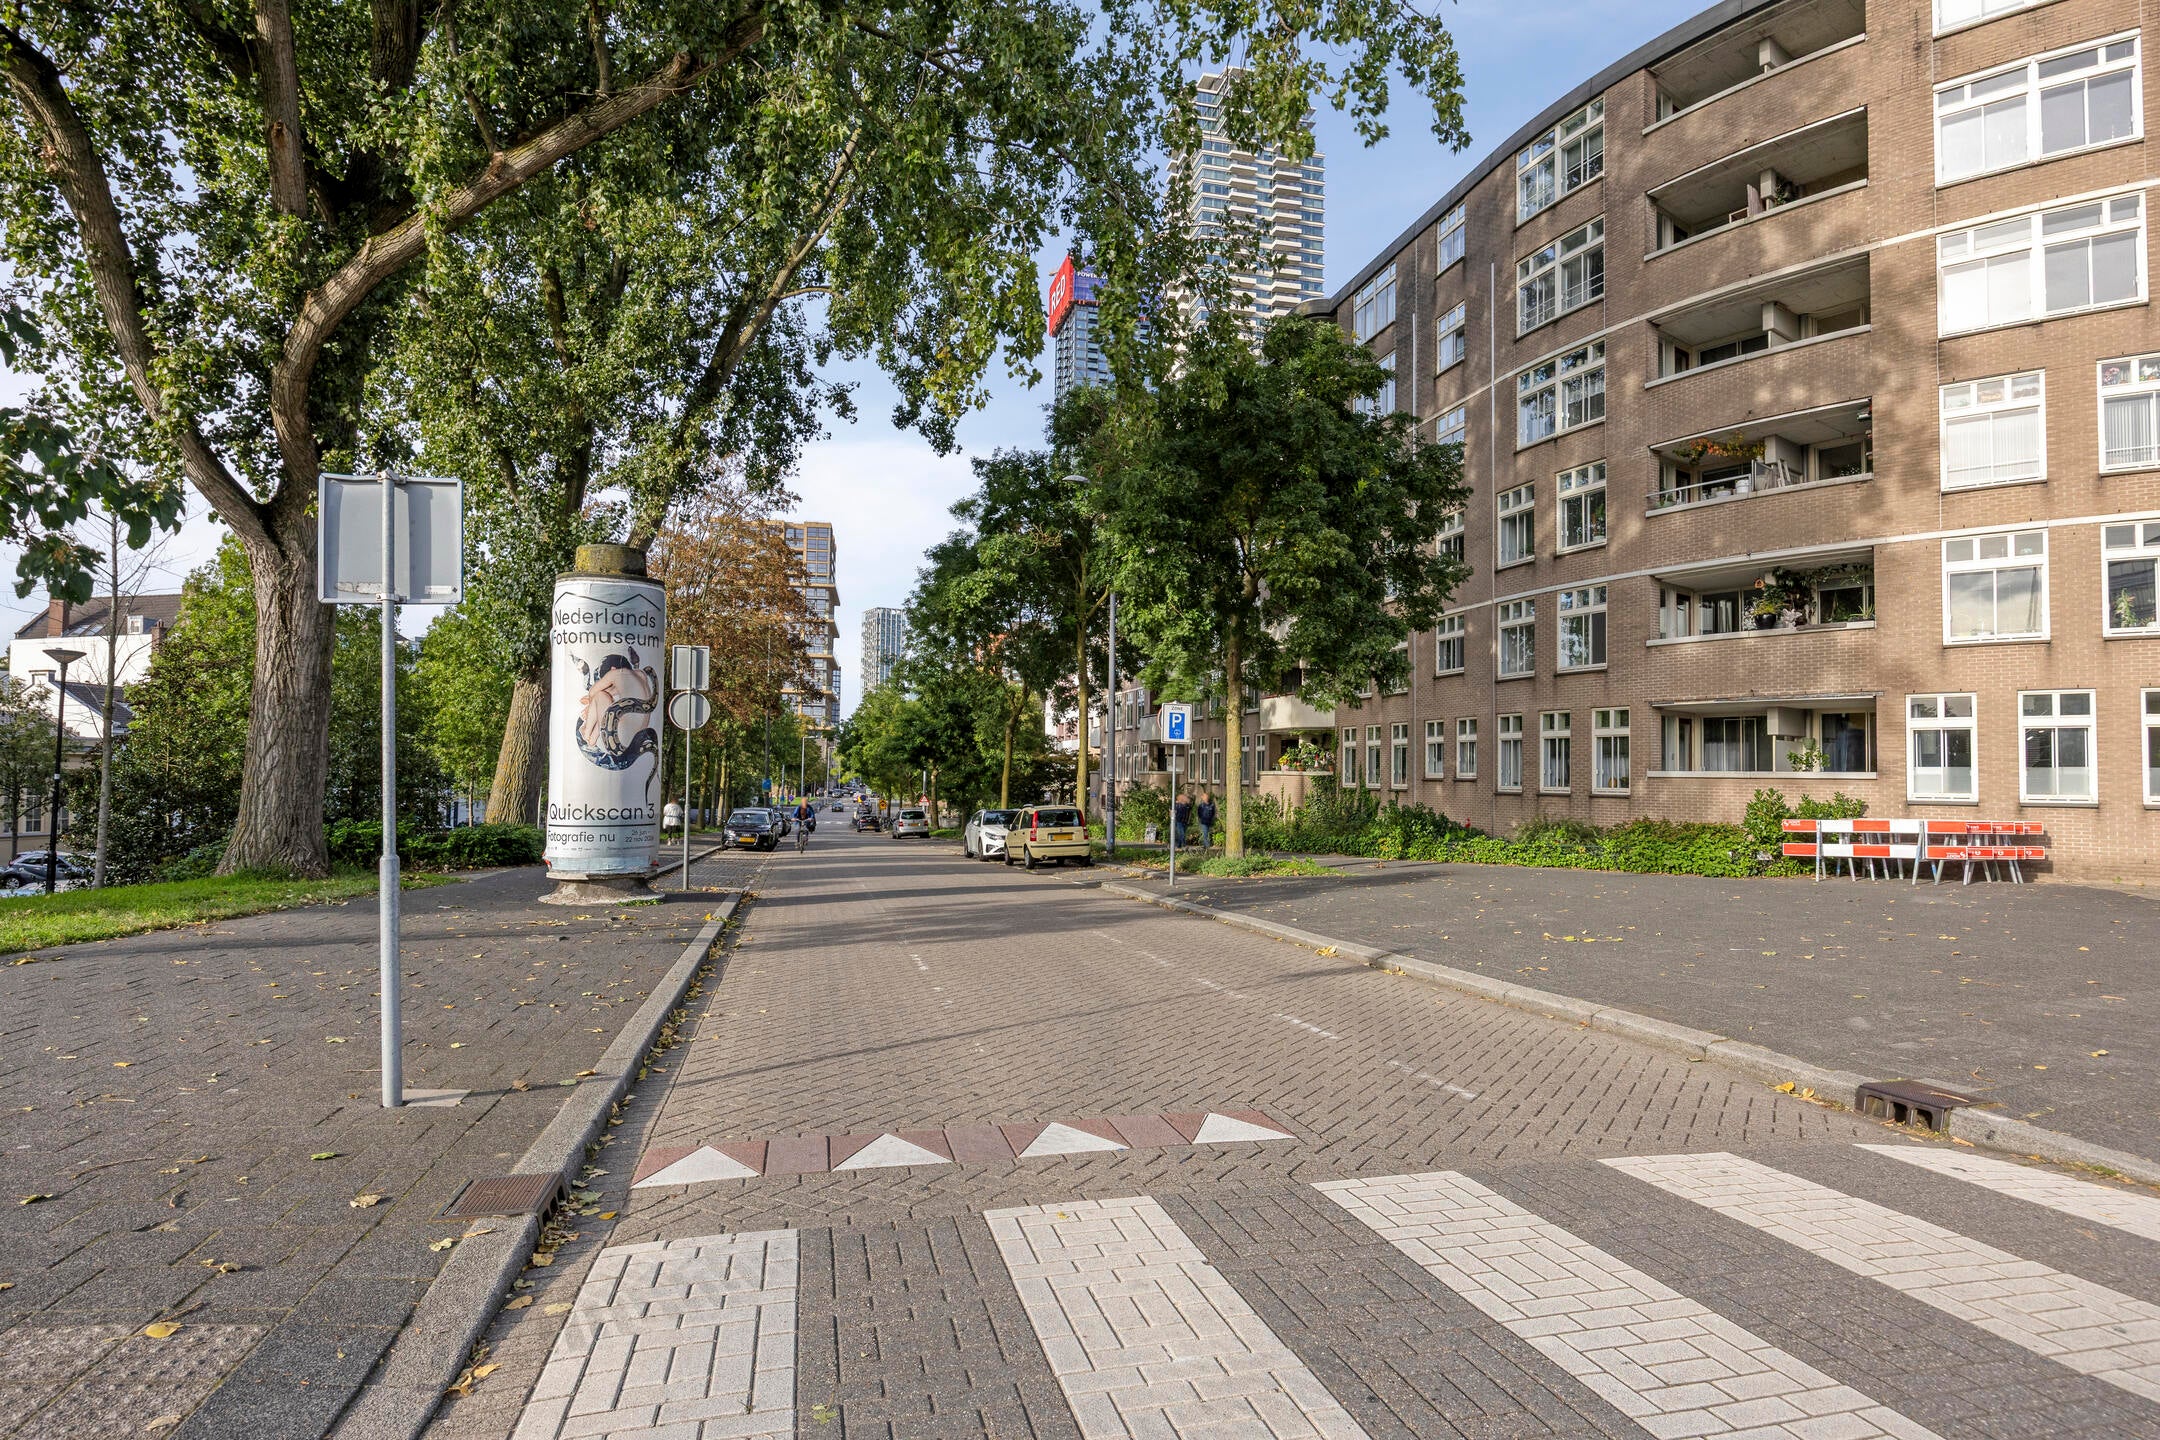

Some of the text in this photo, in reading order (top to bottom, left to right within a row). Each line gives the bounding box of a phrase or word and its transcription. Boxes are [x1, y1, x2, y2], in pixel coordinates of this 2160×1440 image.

[1051, 274, 1066, 316] RED
[554, 607, 656, 628] Nederlands
[1172, 713, 1182, 729] P
[549, 803, 655, 821] Quickscan 3
[599, 833, 615, 842] nu
